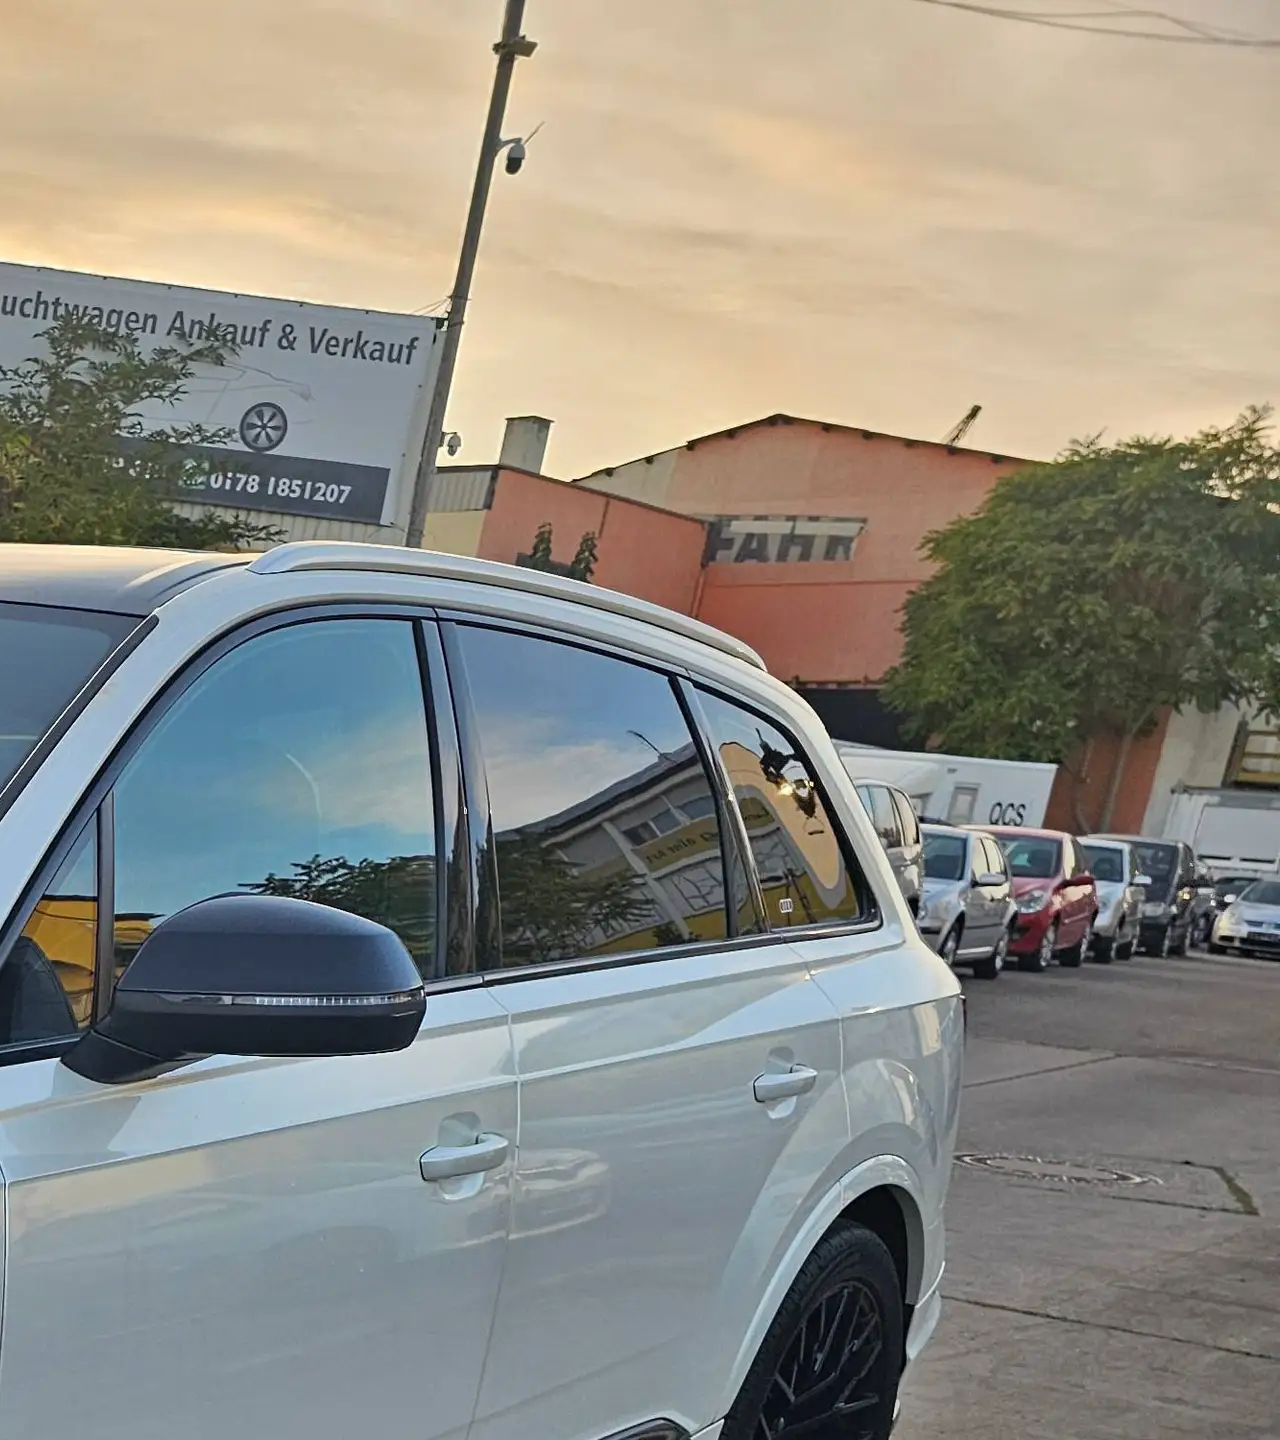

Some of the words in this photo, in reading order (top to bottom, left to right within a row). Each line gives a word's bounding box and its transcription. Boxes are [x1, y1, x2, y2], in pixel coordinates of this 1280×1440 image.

[166, 310, 273, 348] Ankauf
[277, 323, 297, 351] &
[309, 326, 420, 365] Verkauf
[209, 471, 260, 493] 0178
[267, 476, 352, 504] 1851207
